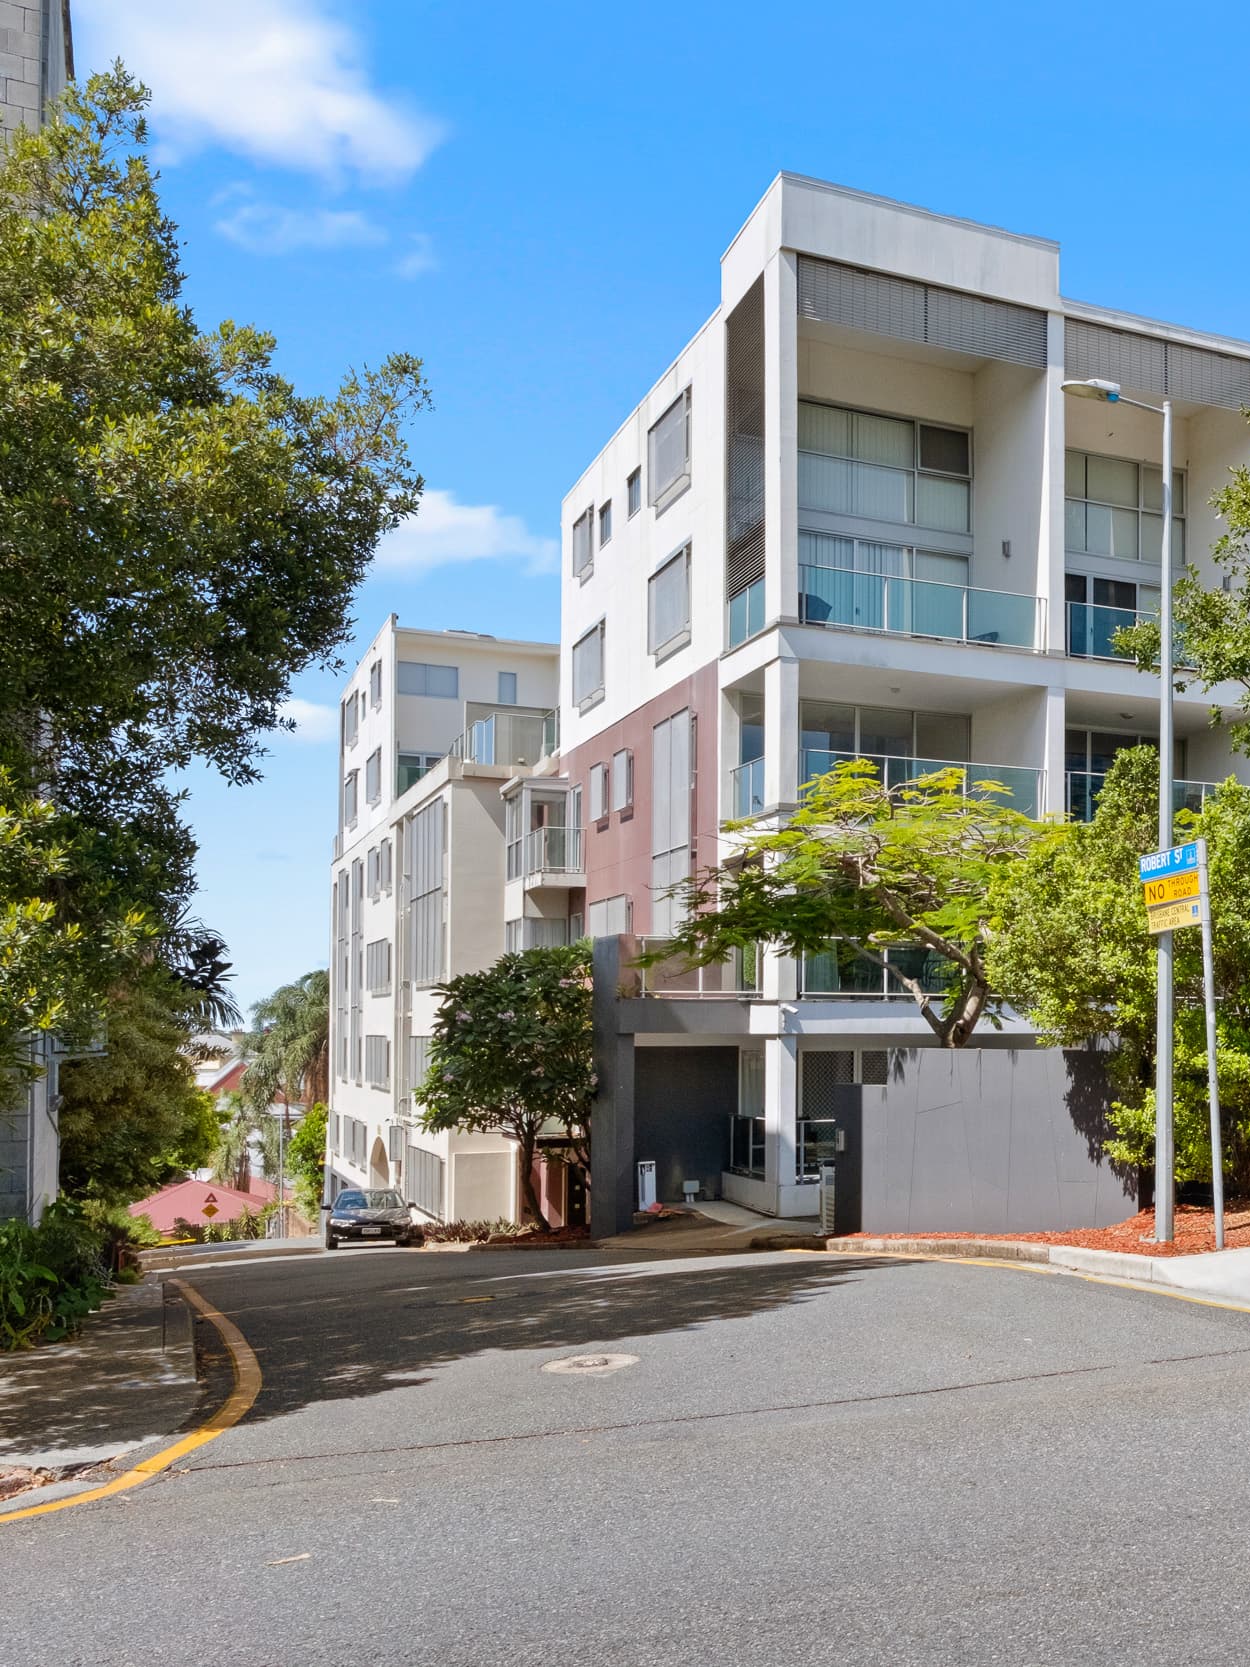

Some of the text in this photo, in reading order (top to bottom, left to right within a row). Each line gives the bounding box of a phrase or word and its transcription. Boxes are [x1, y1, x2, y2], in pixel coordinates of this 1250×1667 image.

[1141, 851, 1171, 873] ROBERT
[1168, 873, 1198, 888] THROUGH
[1149, 883, 1165, 901] NO
[1174, 886, 1191, 897] ROAD
